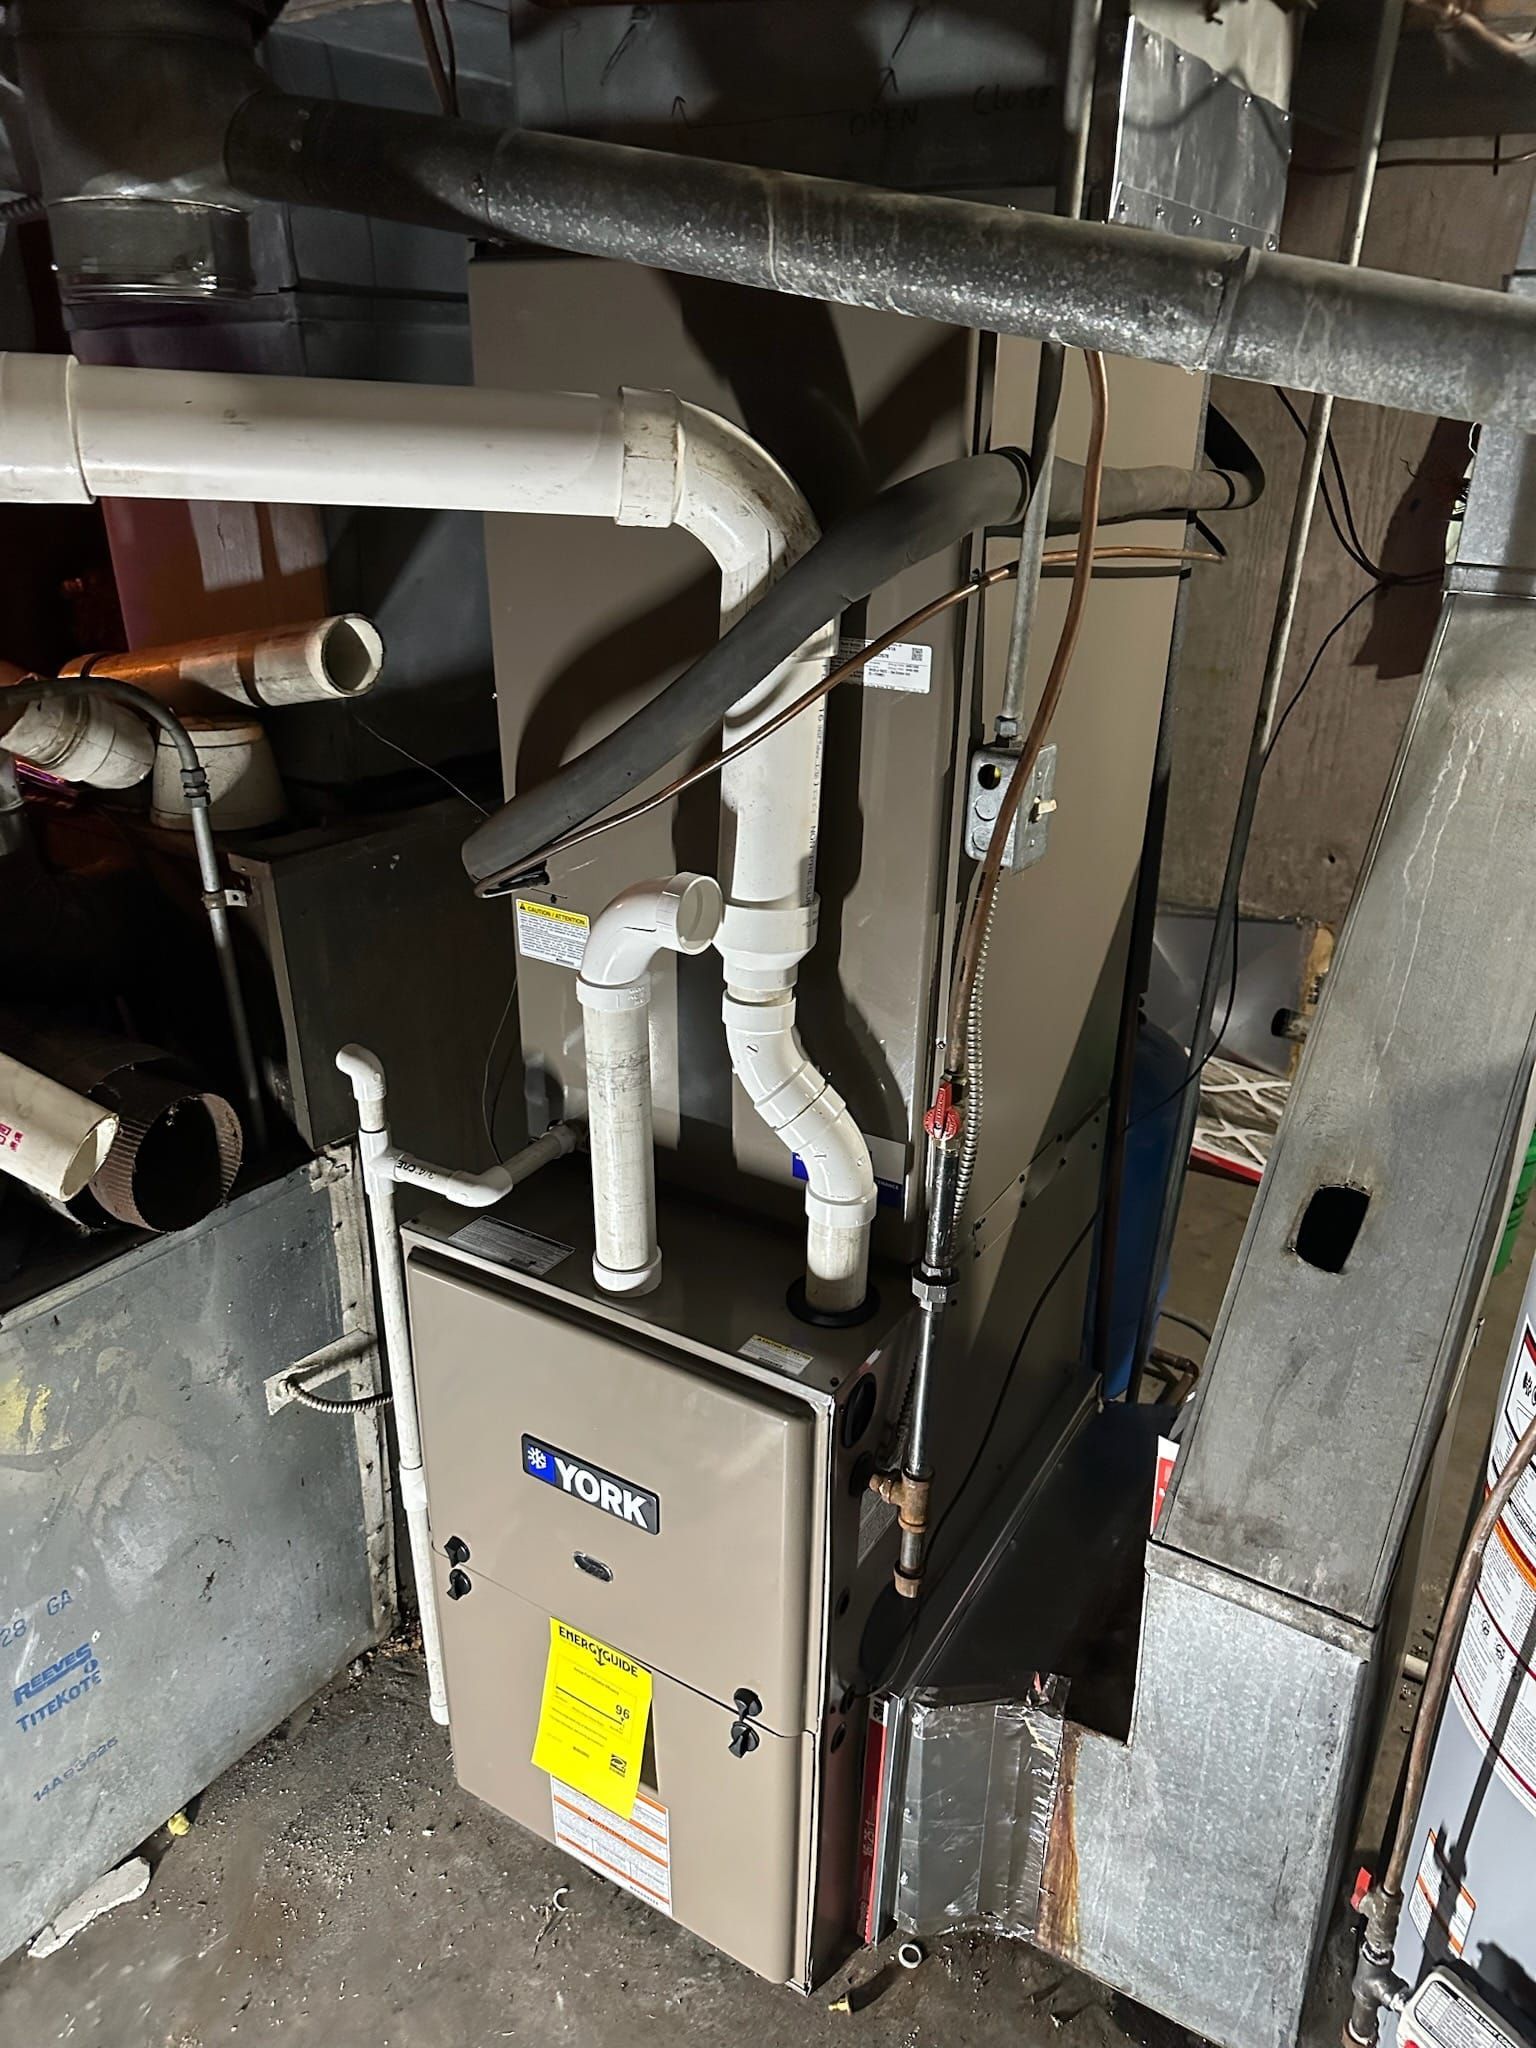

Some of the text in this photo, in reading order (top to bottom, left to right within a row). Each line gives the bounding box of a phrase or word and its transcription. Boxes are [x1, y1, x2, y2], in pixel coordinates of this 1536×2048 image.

[849, 102, 919, 136] OPEN
[805, 855, 815, 906] PRESSUR
[527, 906, 551, 917] CAUTION
[555, 913, 586, 925] ATTENTION
[554, 1457, 648, 1529] YORK
[0, 1589, 73, 1648] 28 GA
[13, 1642, 93, 1707] REEVES
[559, 1625, 638, 1678] ENERGYGUIDE
[16, 1670, 103, 1732] TITEKOTE
[615, 1704, 630, 1720] 96
[1480, 2017, 1499, 2036] LIGHT
[1498, 2034, 1515, 2048] COD
